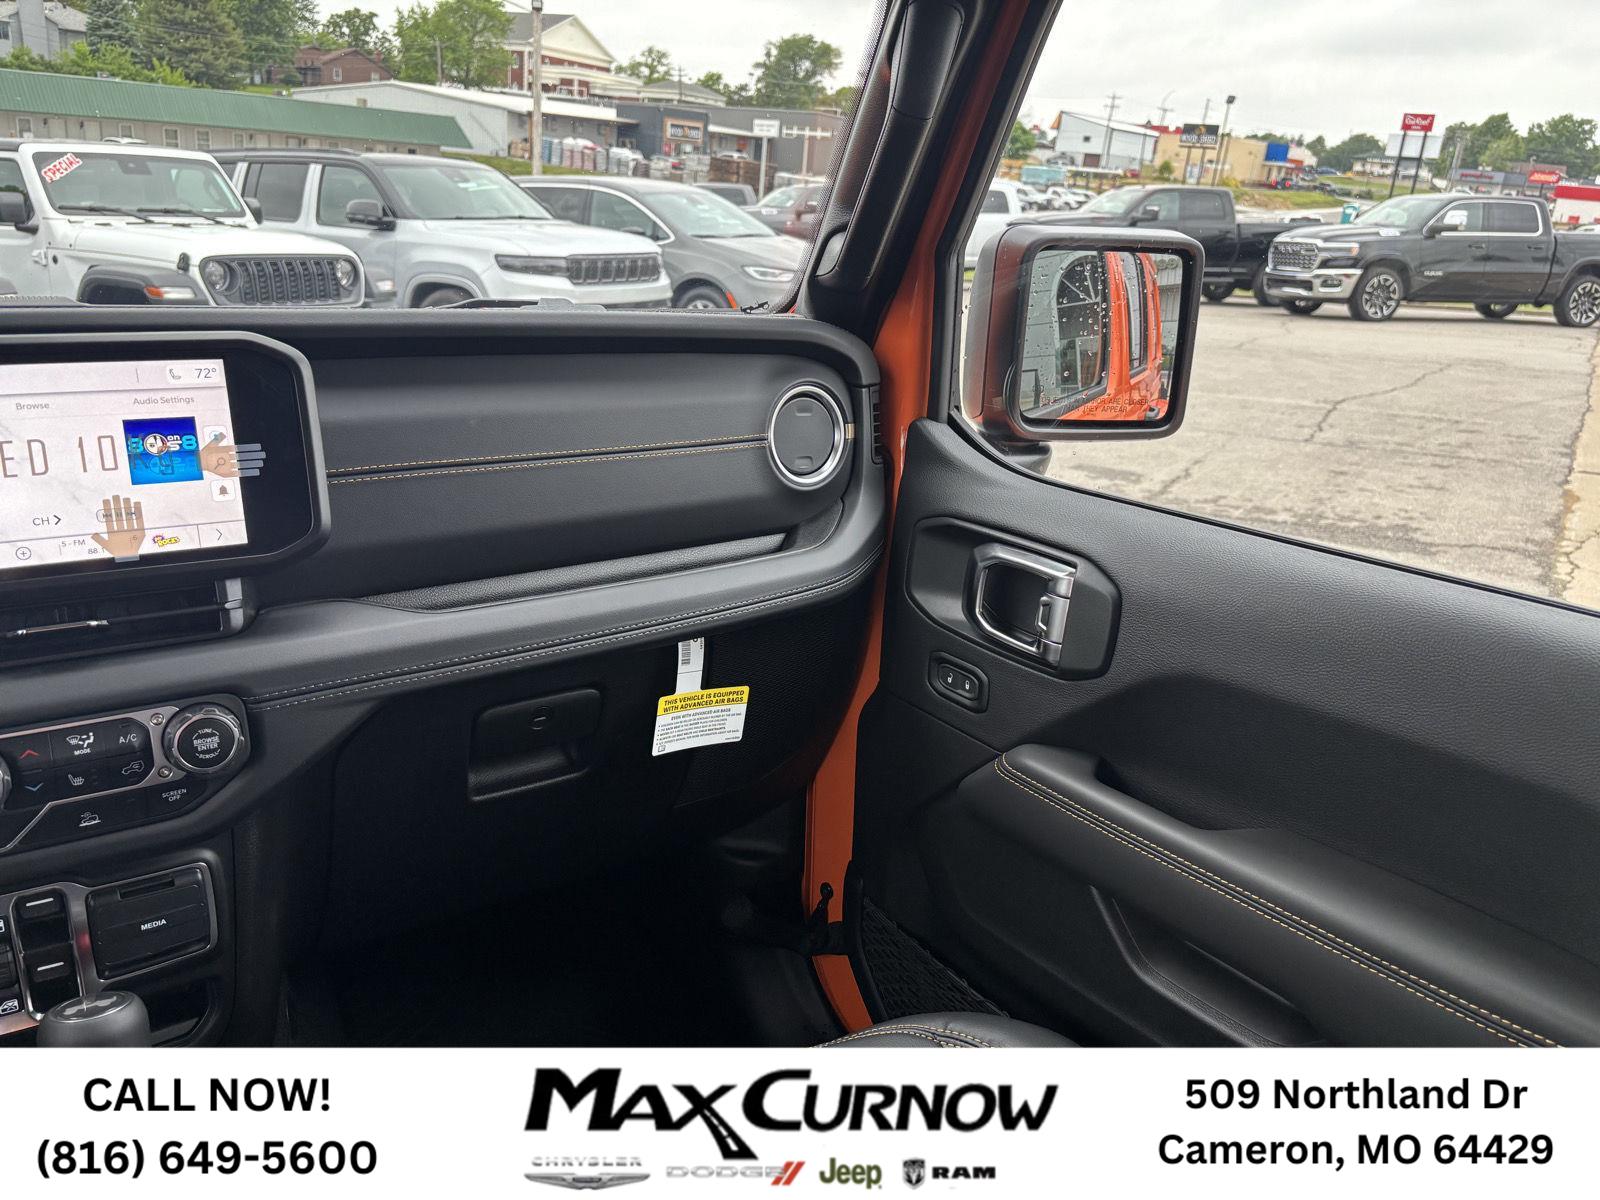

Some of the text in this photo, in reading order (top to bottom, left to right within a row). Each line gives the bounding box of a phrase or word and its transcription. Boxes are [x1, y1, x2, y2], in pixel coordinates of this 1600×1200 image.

[43, 154, 80, 181] SPECIAL
[133, 394, 195, 406] Audio Settings
[1124, 398, 1149, 406] CLOSER
[16, 402, 50, 410] Browse
[1083, 405, 1098, 413] THEY
[1101, 405, 1128, 413] APPEAR
[182, 434, 198, 450] 8
[32, 516, 50, 527] CH
[74, 539, 86, 547] FM
[663, 697, 678, 706] THIS
[679, 694, 704, 704] VEHICLE
[713, 690, 745, 698] EQUIPPED
[663, 704, 679, 713] WITH
[680, 699, 713, 709] ADVANCED
[119, 733, 137, 744] A/C
[193, 735, 220, 746] BROWSE
[74, 747, 91, 756] MODE
[197, 742, 218, 751] ENTER
[198, 750, 219, 759] SCROLL
[162, 788, 187, 798] SCREEN
[140, 918, 167, 931] MEDIA
